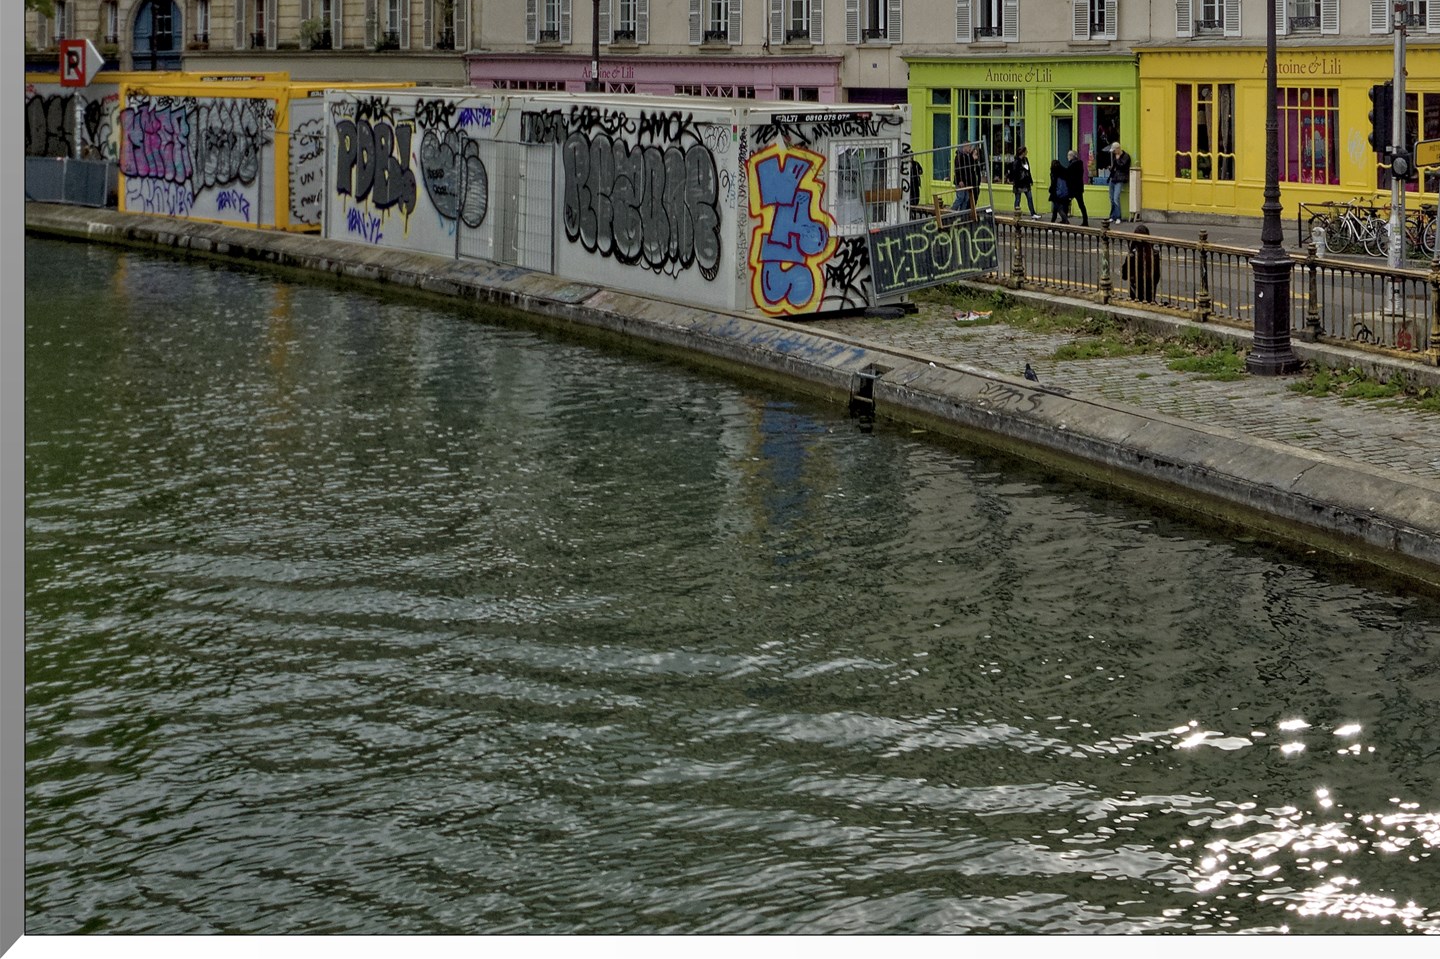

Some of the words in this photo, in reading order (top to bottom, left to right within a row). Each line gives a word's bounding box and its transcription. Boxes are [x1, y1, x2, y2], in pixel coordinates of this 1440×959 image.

[621, 66, 634, 79] Lili
[1308, 56, 1321, 74] &
[1322, 58, 1341, 75] Lili
[985, 68, 1022, 82] Antoine
[1024, 67, 1035, 82] &
[1036, 68, 1052, 82] Lili
[805, 114, 822, 122] 0810
